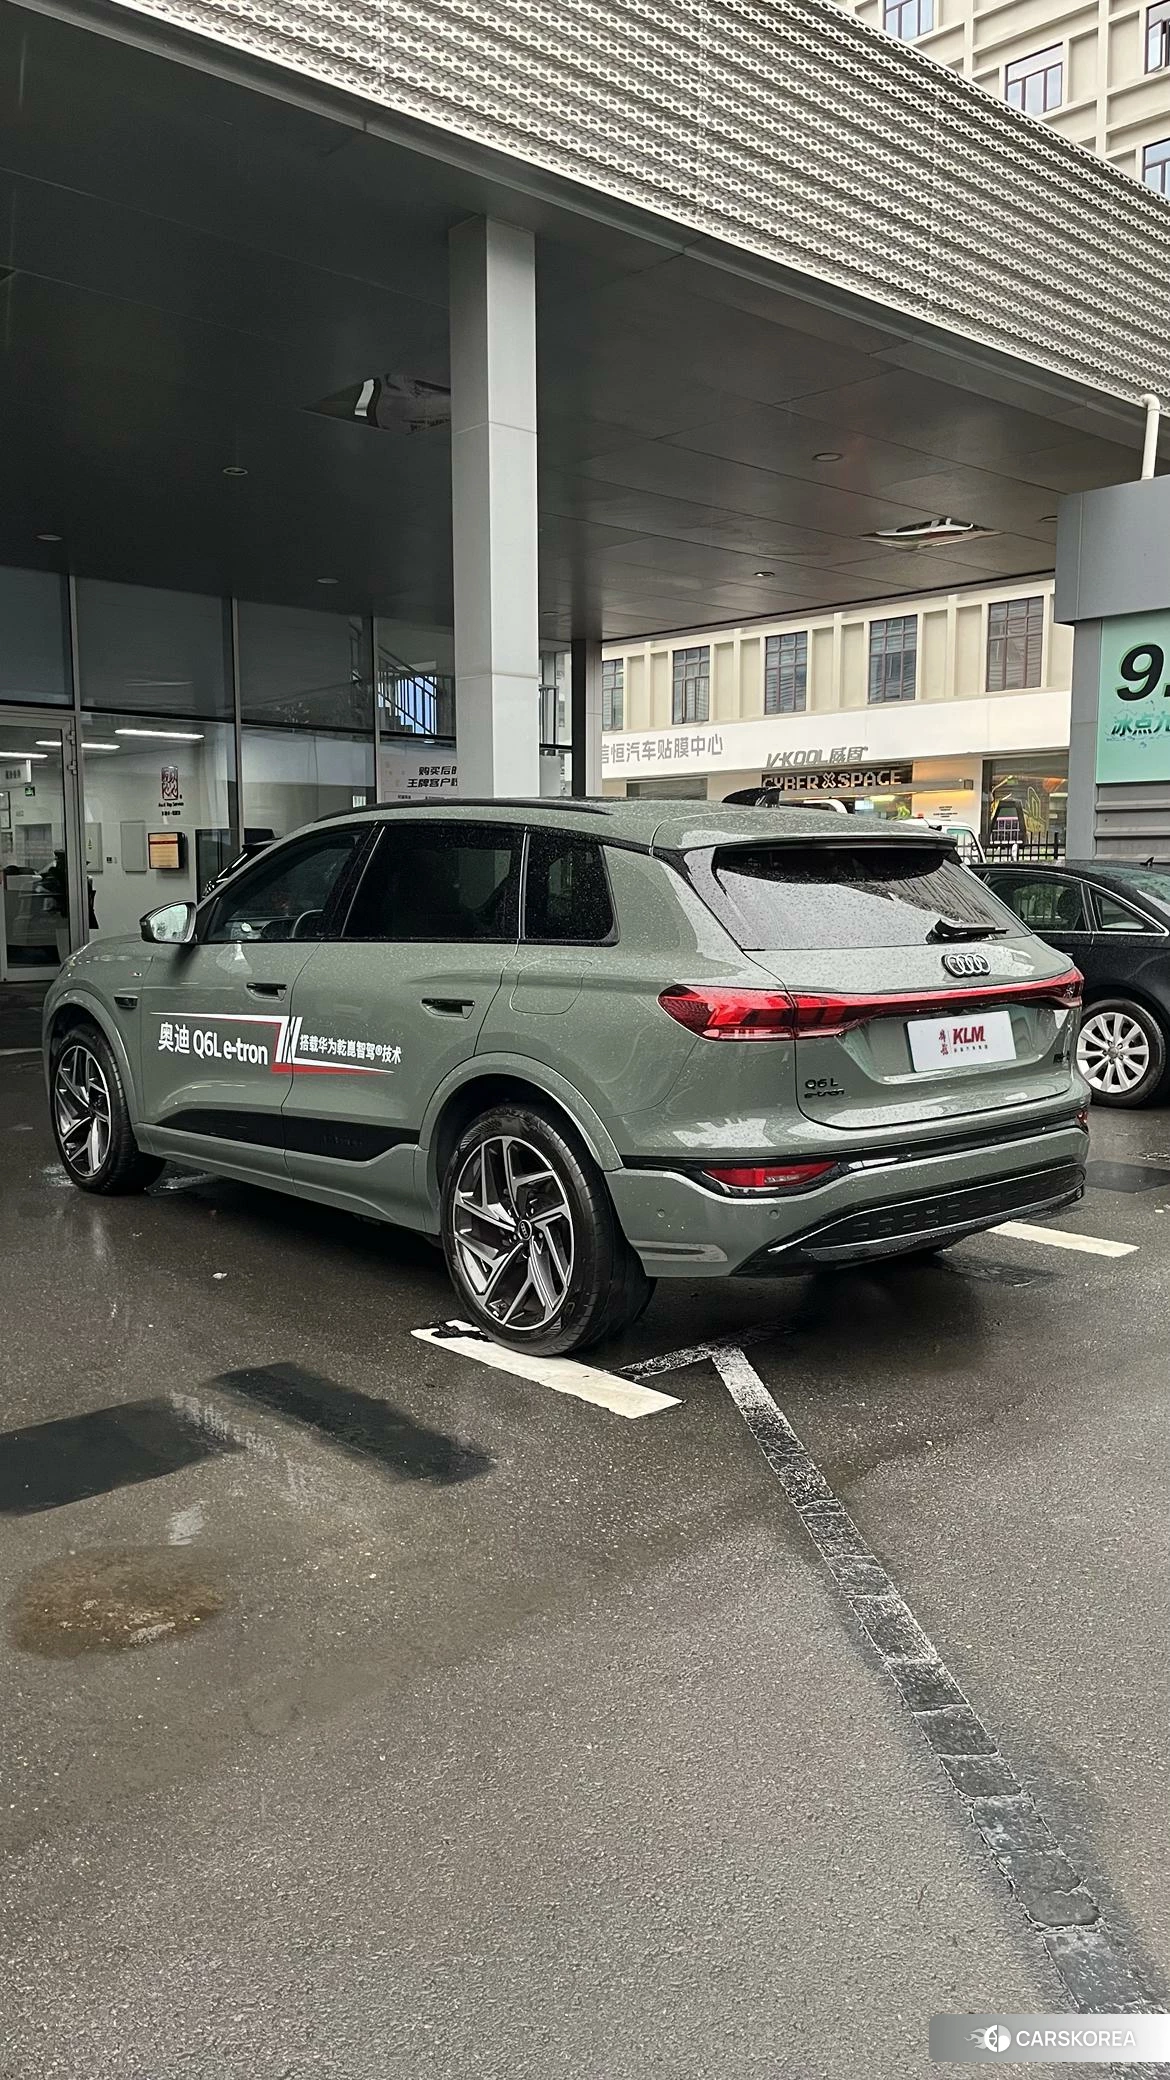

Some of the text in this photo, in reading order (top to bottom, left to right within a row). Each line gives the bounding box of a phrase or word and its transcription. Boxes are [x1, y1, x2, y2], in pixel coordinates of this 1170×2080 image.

[837, 769, 901, 789] SPACE
[158, 1021, 268, 1066] 奥迪 Q6L e-tron
[952, 1025, 986, 1044] KLM
